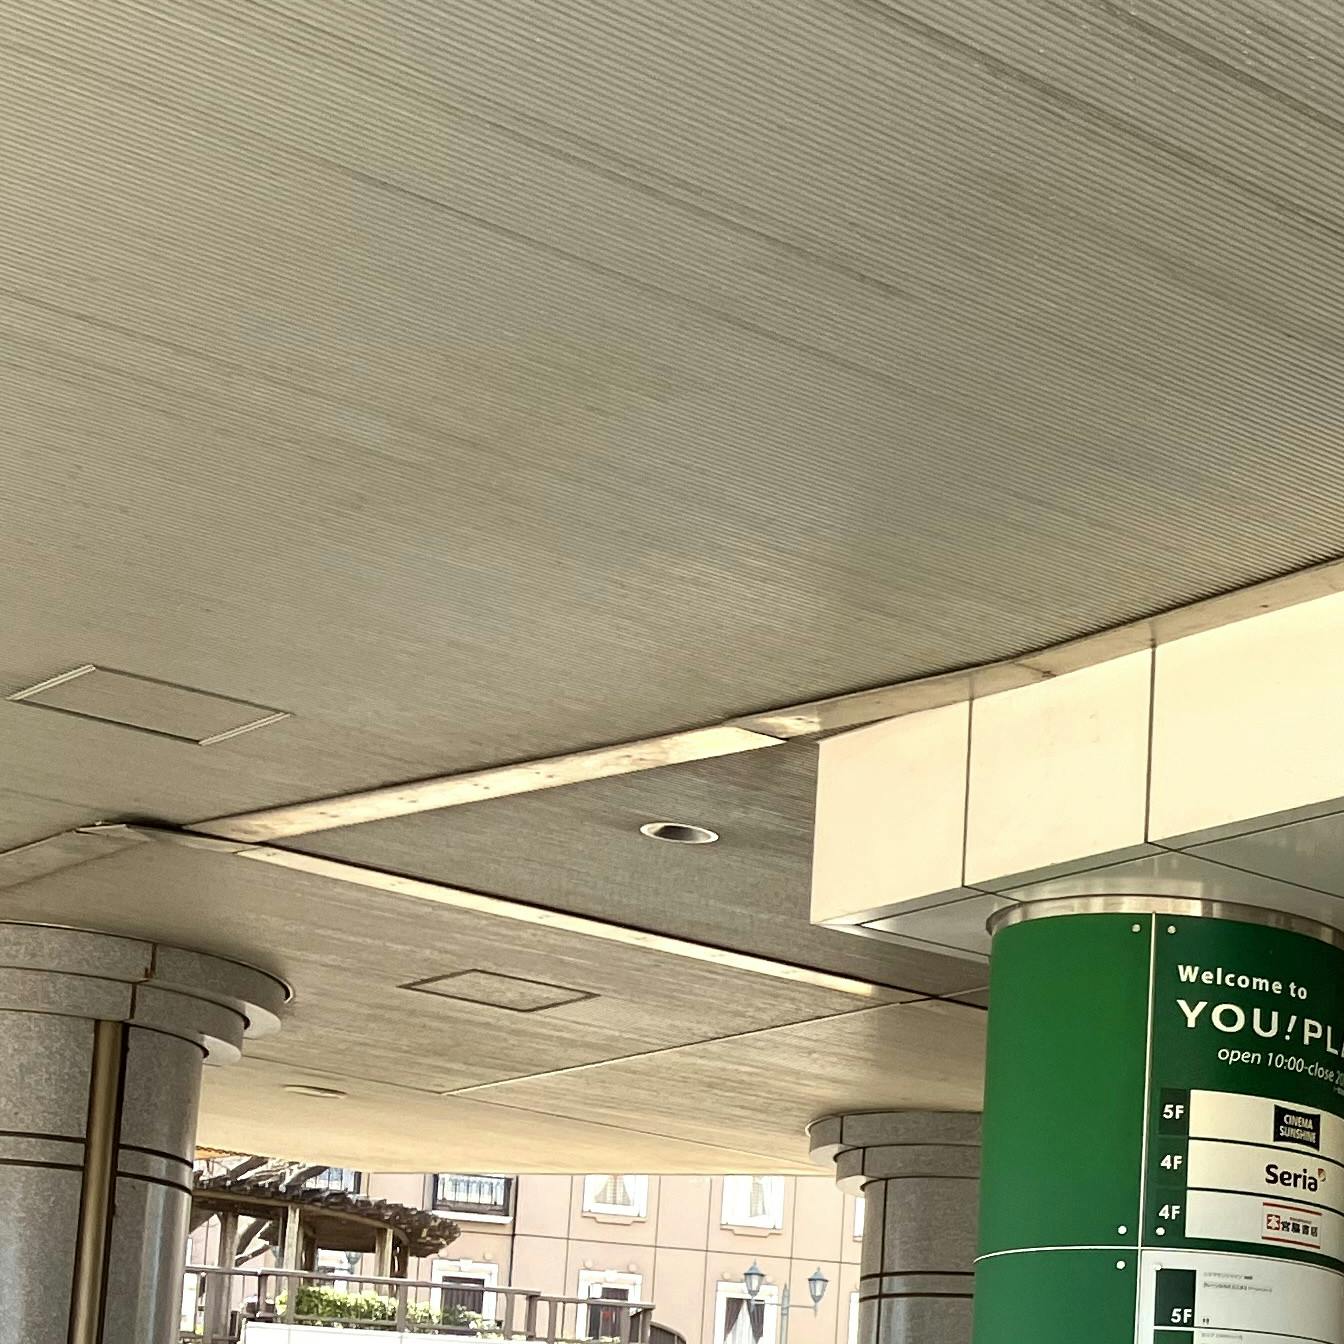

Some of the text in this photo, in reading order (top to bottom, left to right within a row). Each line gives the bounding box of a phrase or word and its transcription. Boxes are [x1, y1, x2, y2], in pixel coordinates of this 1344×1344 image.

[1177, 964, 1308, 1000] Welcome to
[1217, 1048, 1335, 1083] open 10:00-close
[1162, 1104, 1185, 1120] 5F
[1283, 1113, 1313, 1130] CINEMA
[1279, 1125, 1317, 1144] SUNSHINE
[1160, 1154, 1183, 1170] 4F
[1264, 1163, 1319, 1193] Seria
[1158, 1204, 1181, 1220] 4F
[1170, 1308, 1193, 1324] 5F
